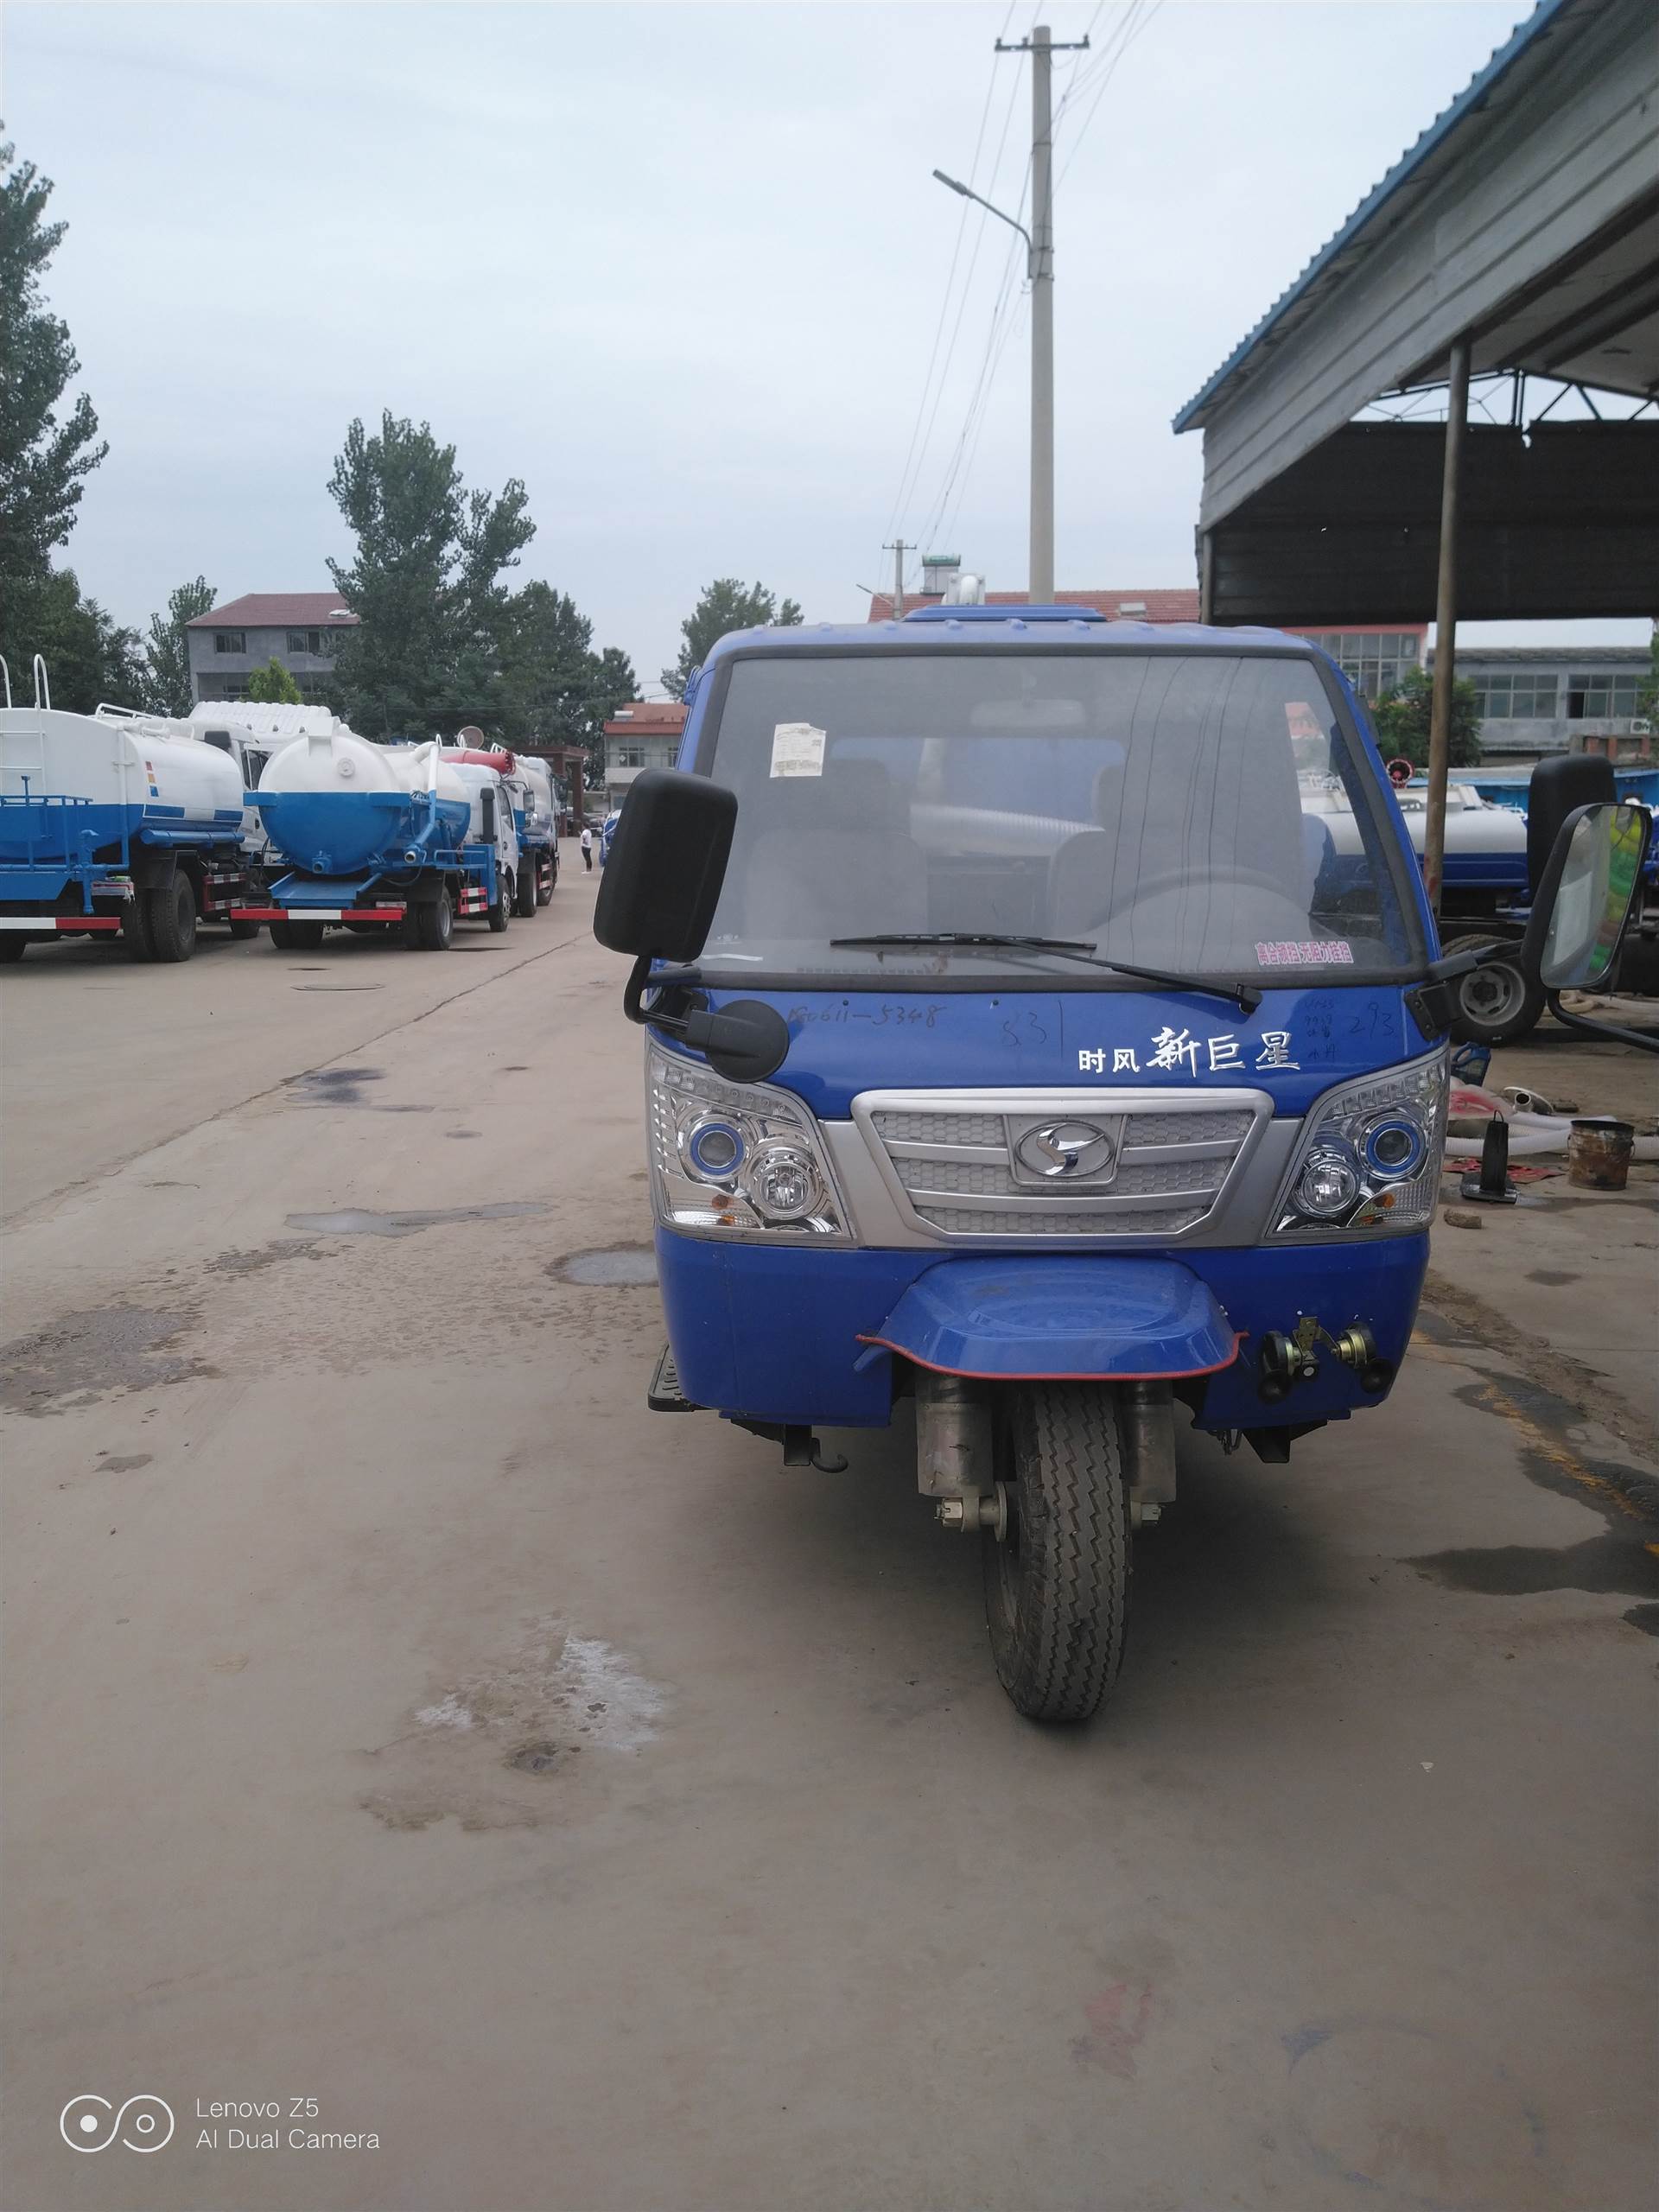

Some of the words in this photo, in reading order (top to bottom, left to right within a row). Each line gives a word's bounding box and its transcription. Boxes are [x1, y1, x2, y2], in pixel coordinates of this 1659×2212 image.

[1078, 1048, 1141, 1074] 时风
[1146, 1027, 1301, 1078] 新巨星
